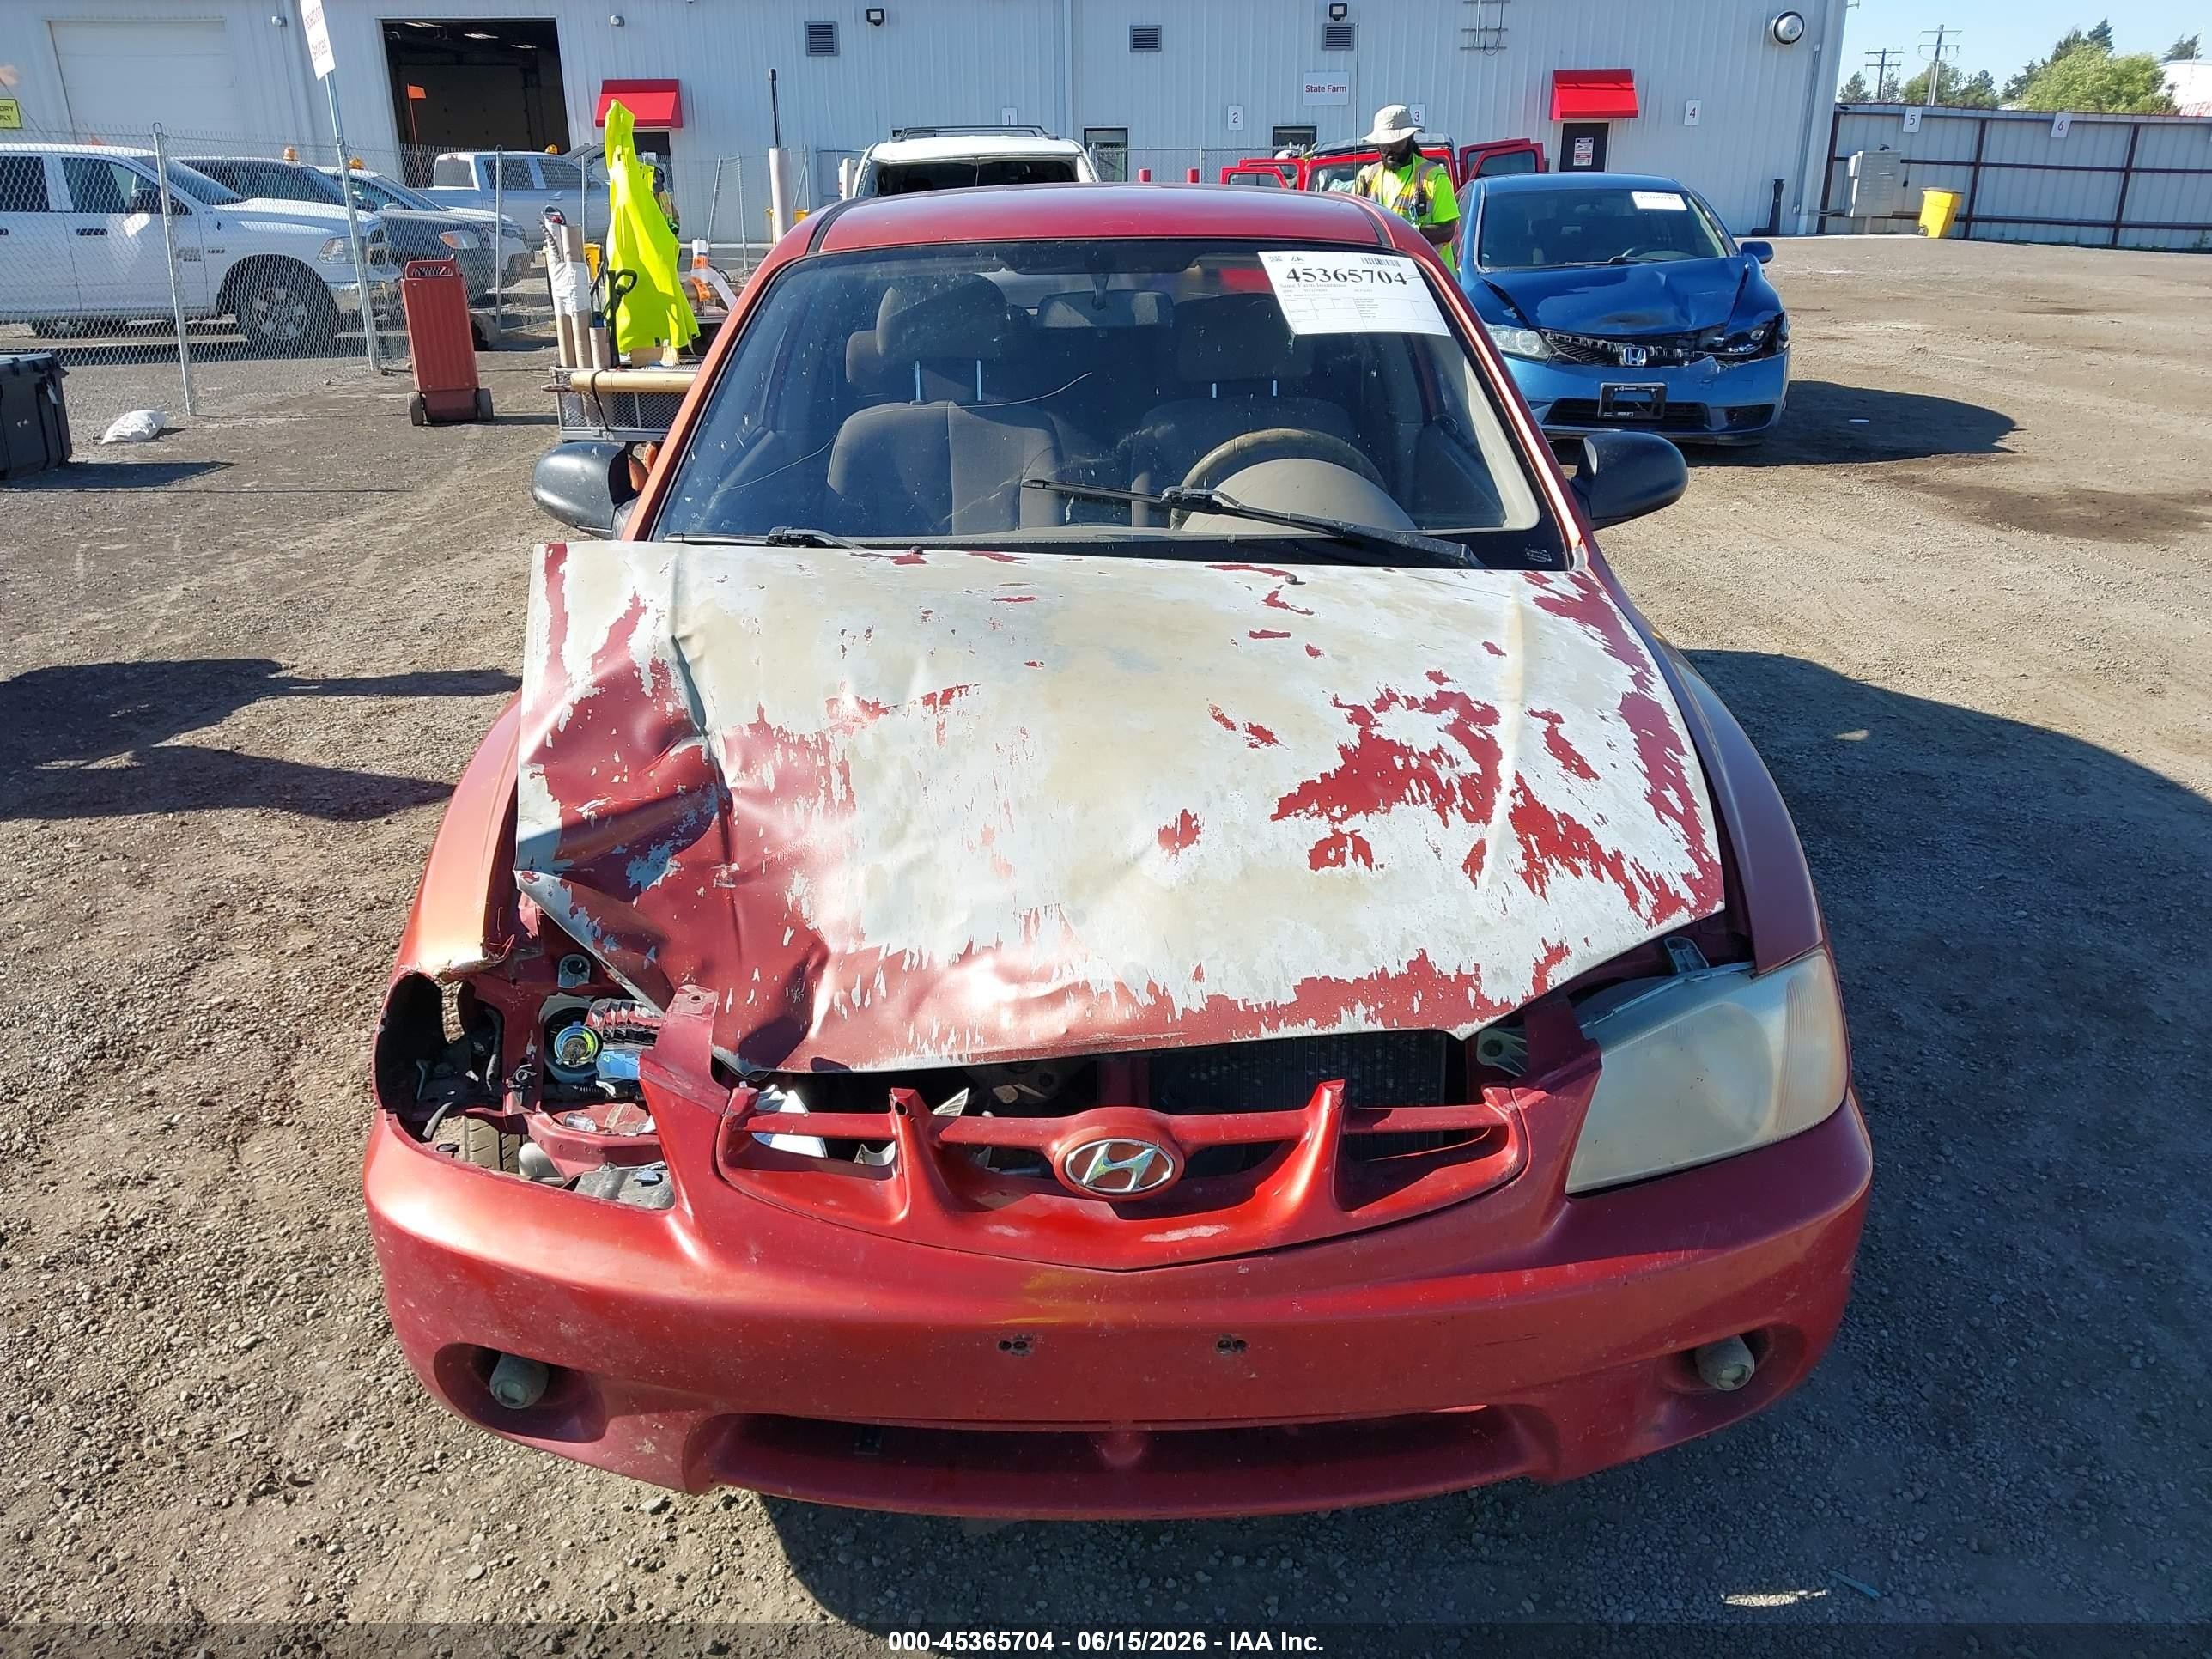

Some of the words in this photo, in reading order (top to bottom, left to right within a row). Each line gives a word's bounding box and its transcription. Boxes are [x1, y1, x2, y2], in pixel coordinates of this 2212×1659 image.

[1305, 84, 1325, 93] State
[1328, 84, 1347, 93] Farm
[1232, 112, 1239, 124] 2
[1414, 111, 1420, 122] 3
[1689, 106, 1697, 119] 4
[1909, 114, 1916, 125] 5
[2057, 119, 2065, 131] 6
[1286, 268, 1407, 285] 45365704
